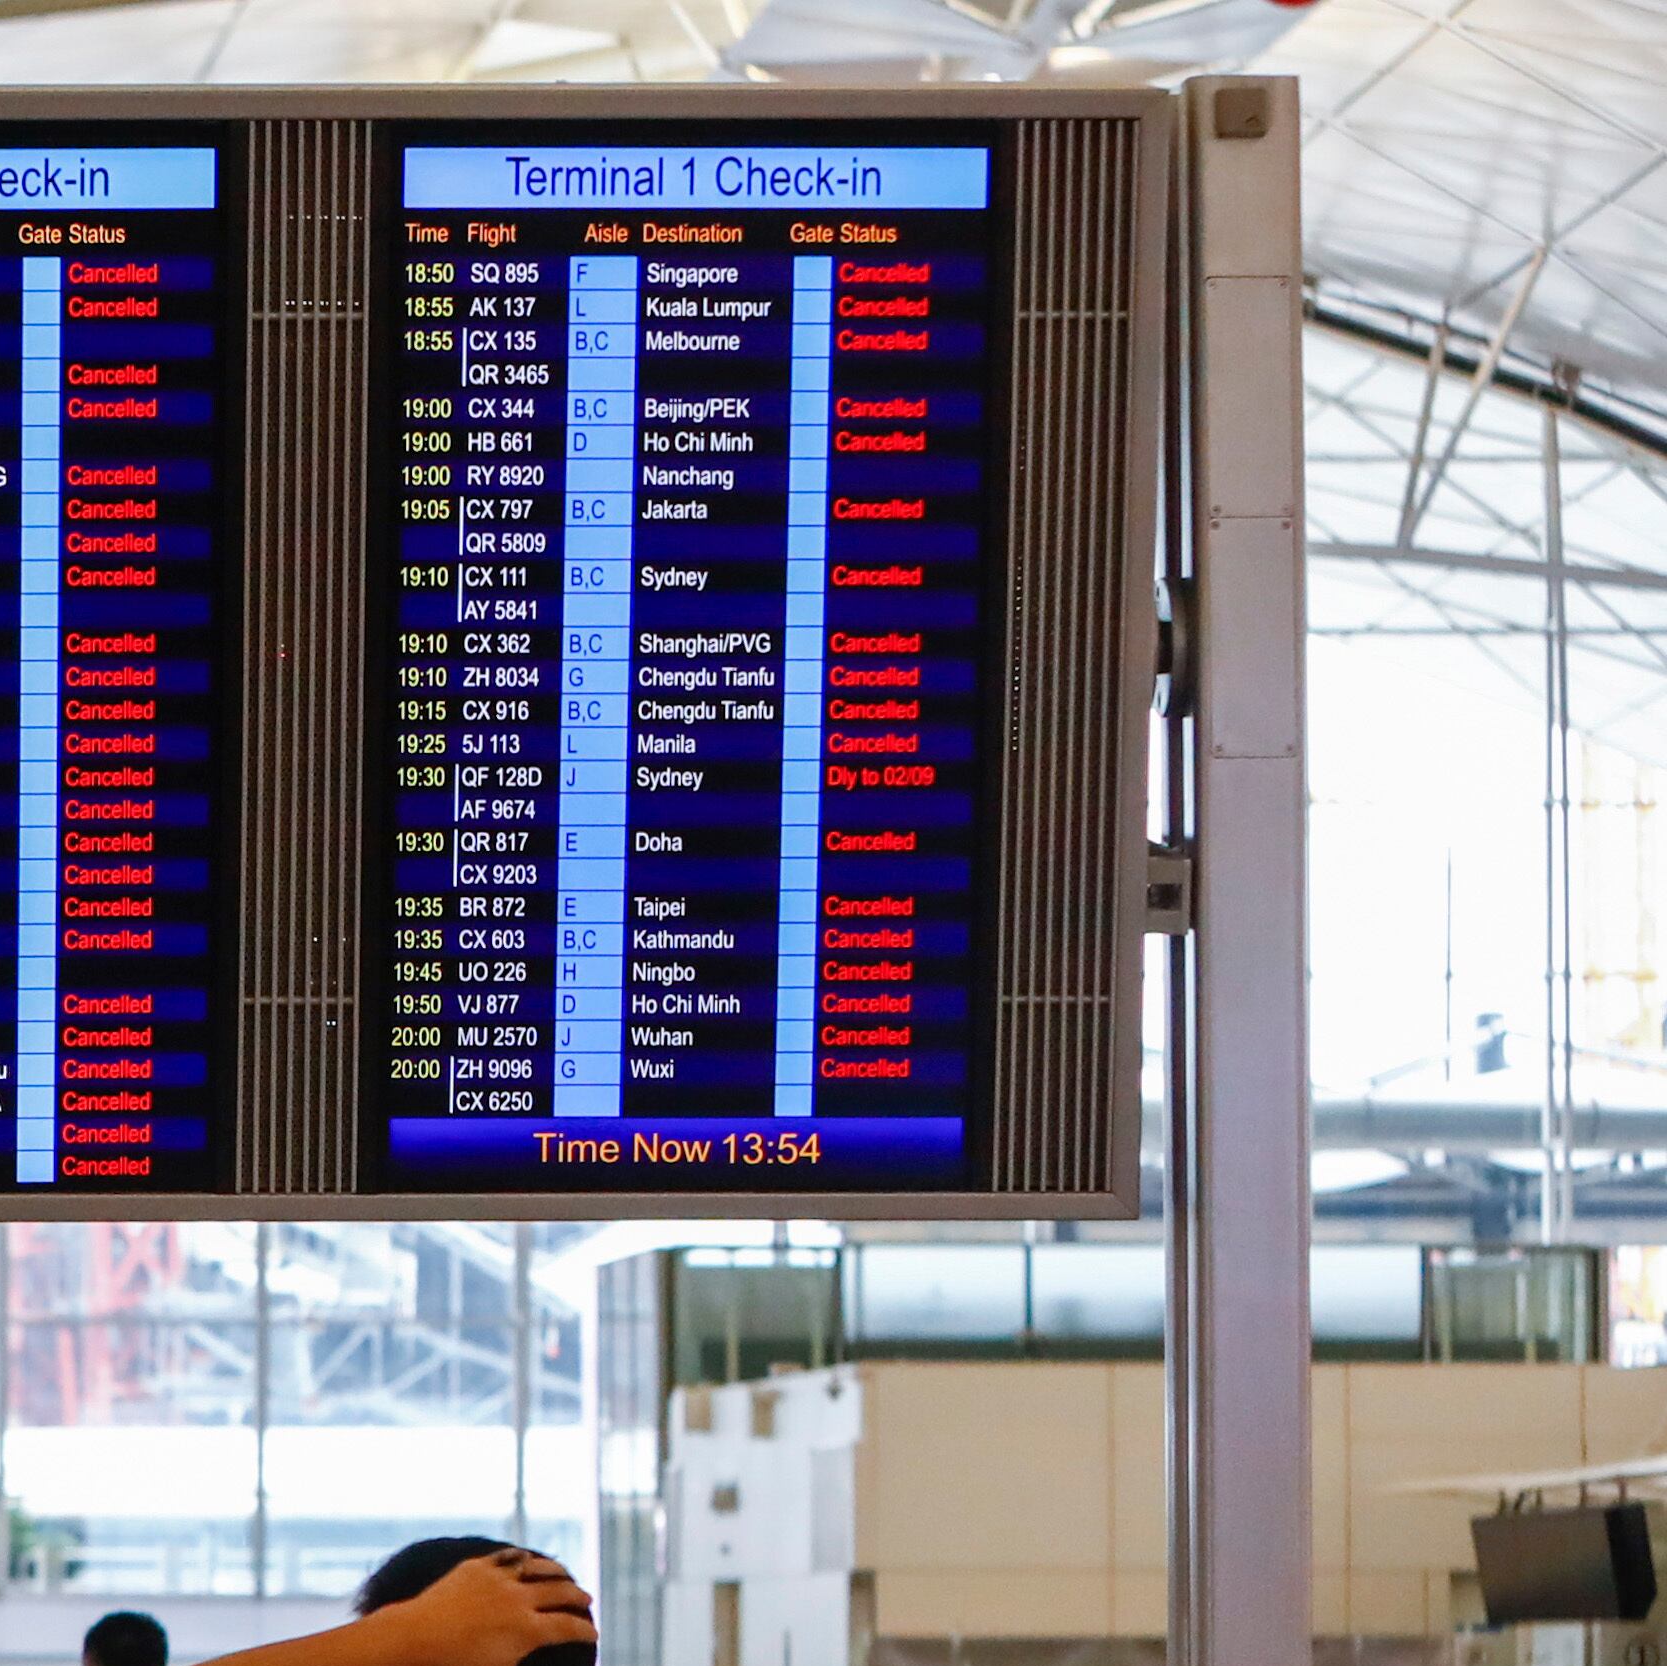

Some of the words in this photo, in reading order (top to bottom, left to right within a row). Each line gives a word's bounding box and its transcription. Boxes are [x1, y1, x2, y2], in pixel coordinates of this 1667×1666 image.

[506, 157, 663, 196] Terminal
[683, 157, 694, 195] 1
[716, 156, 880, 196] Check-in
[19, 223, 62, 244] Gate
[69, 223, 125, 243] Status
[406, 223, 449, 242] Time
[468, 223, 516, 248] Flight
[585, 224, 628, 242] Aisle
[643, 223, 742, 242] Destination
[790, 222, 834, 242] Gate
[840, 223, 897, 242] Status
[406, 263, 454, 283] 18:50
[471, 263, 500, 283] SQ
[505, 263, 539, 283] 895
[577, 263, 588, 282] F
[647, 263, 738, 288] Singapore
[839, 262, 930, 283] Cancelled
[67, 465, 157, 485] Cancelled
[398, 767, 445, 786] 19:30
[462, 767, 489, 787] QF
[497, 767, 542, 786] 128D
[566, 768, 575, 787] J
[637, 767, 703, 791] Sydney
[827, 766, 857, 790] Dly
[861, 768, 881, 785] to
[883, 766, 935, 786] 02/09
[461, 800, 486, 818] AF
[492, 800, 535, 819] 9674
[64, 897, 152, 917] Cancelled
[533, 1132, 620, 1162] Time
[634, 1133, 711, 1162] Now
[723, 1133, 821, 1164] 13:54
[62, 1156, 150, 1175] Cancelled
